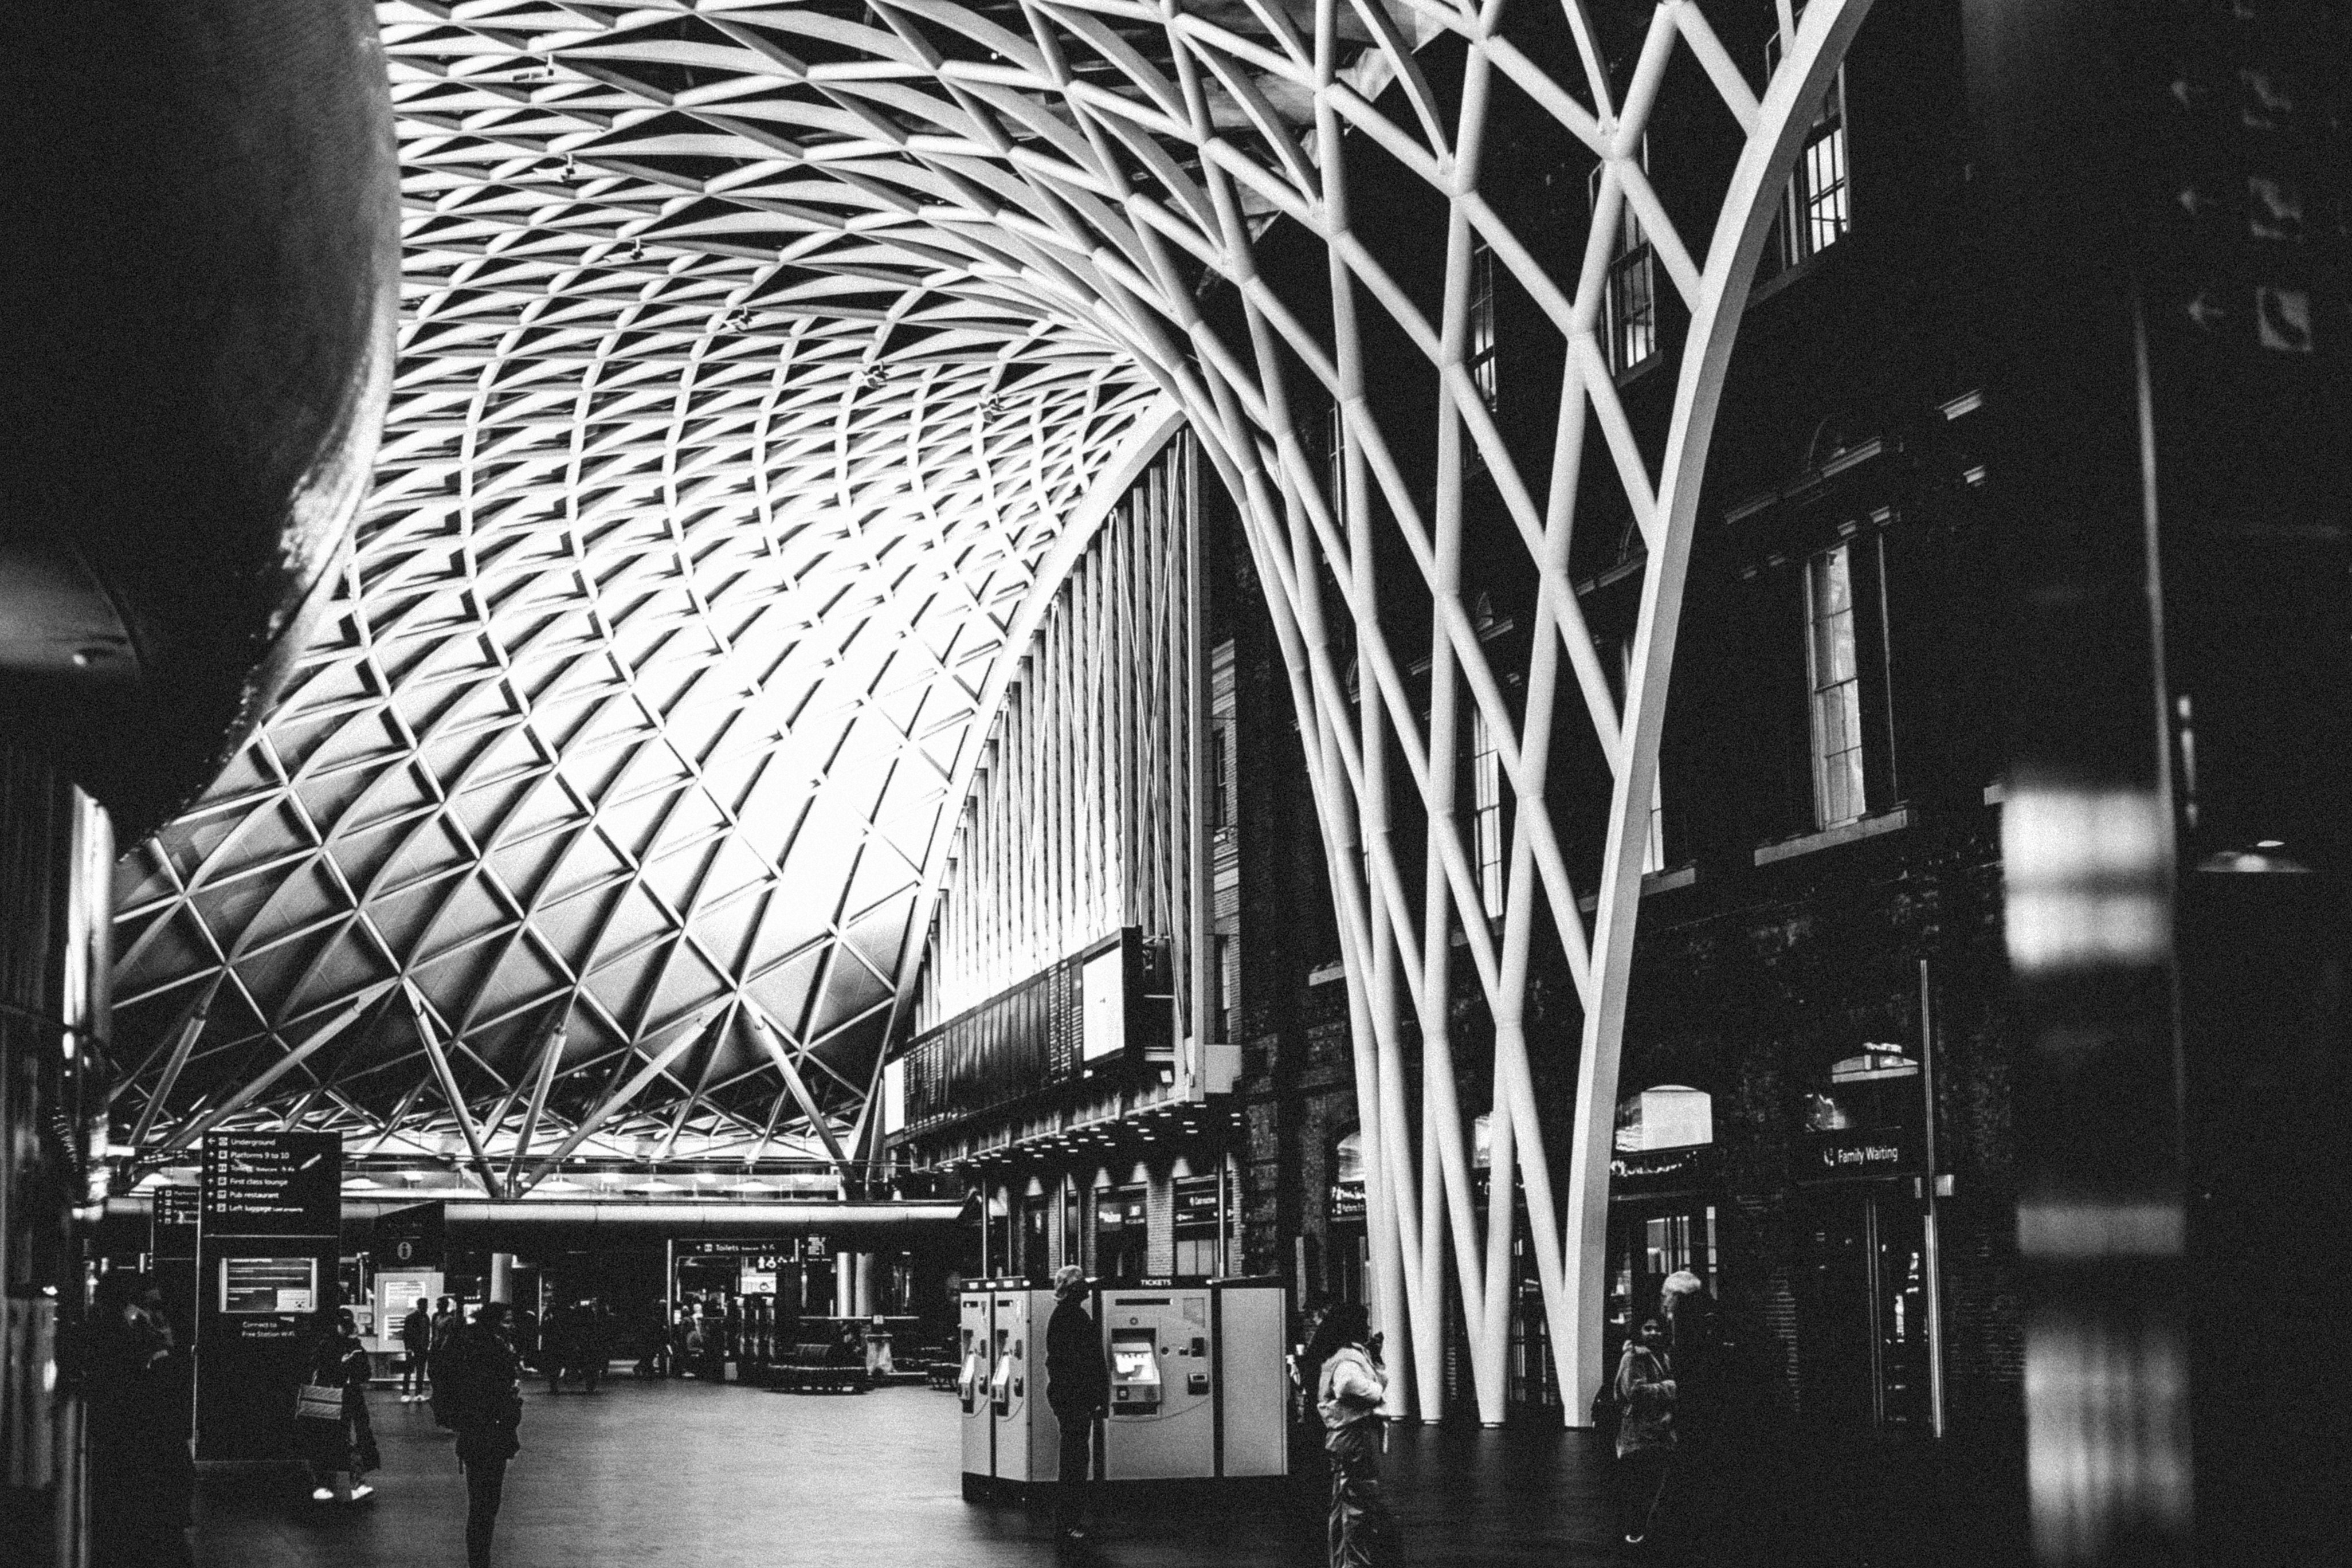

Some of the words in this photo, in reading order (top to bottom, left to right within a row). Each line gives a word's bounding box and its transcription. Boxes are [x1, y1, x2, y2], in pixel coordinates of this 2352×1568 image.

[1838, 1148, 1864, 1165] Family
[1865, 1145, 1898, 1162] Waiting
[230, 1164, 253, 1173] Toil
[264, 1178, 288, 1187] lounge
[230, 1190, 243, 1198] Pub
[245, 1205, 272, 1213] luggage
[716, 1244, 739, 1252] Toilets
